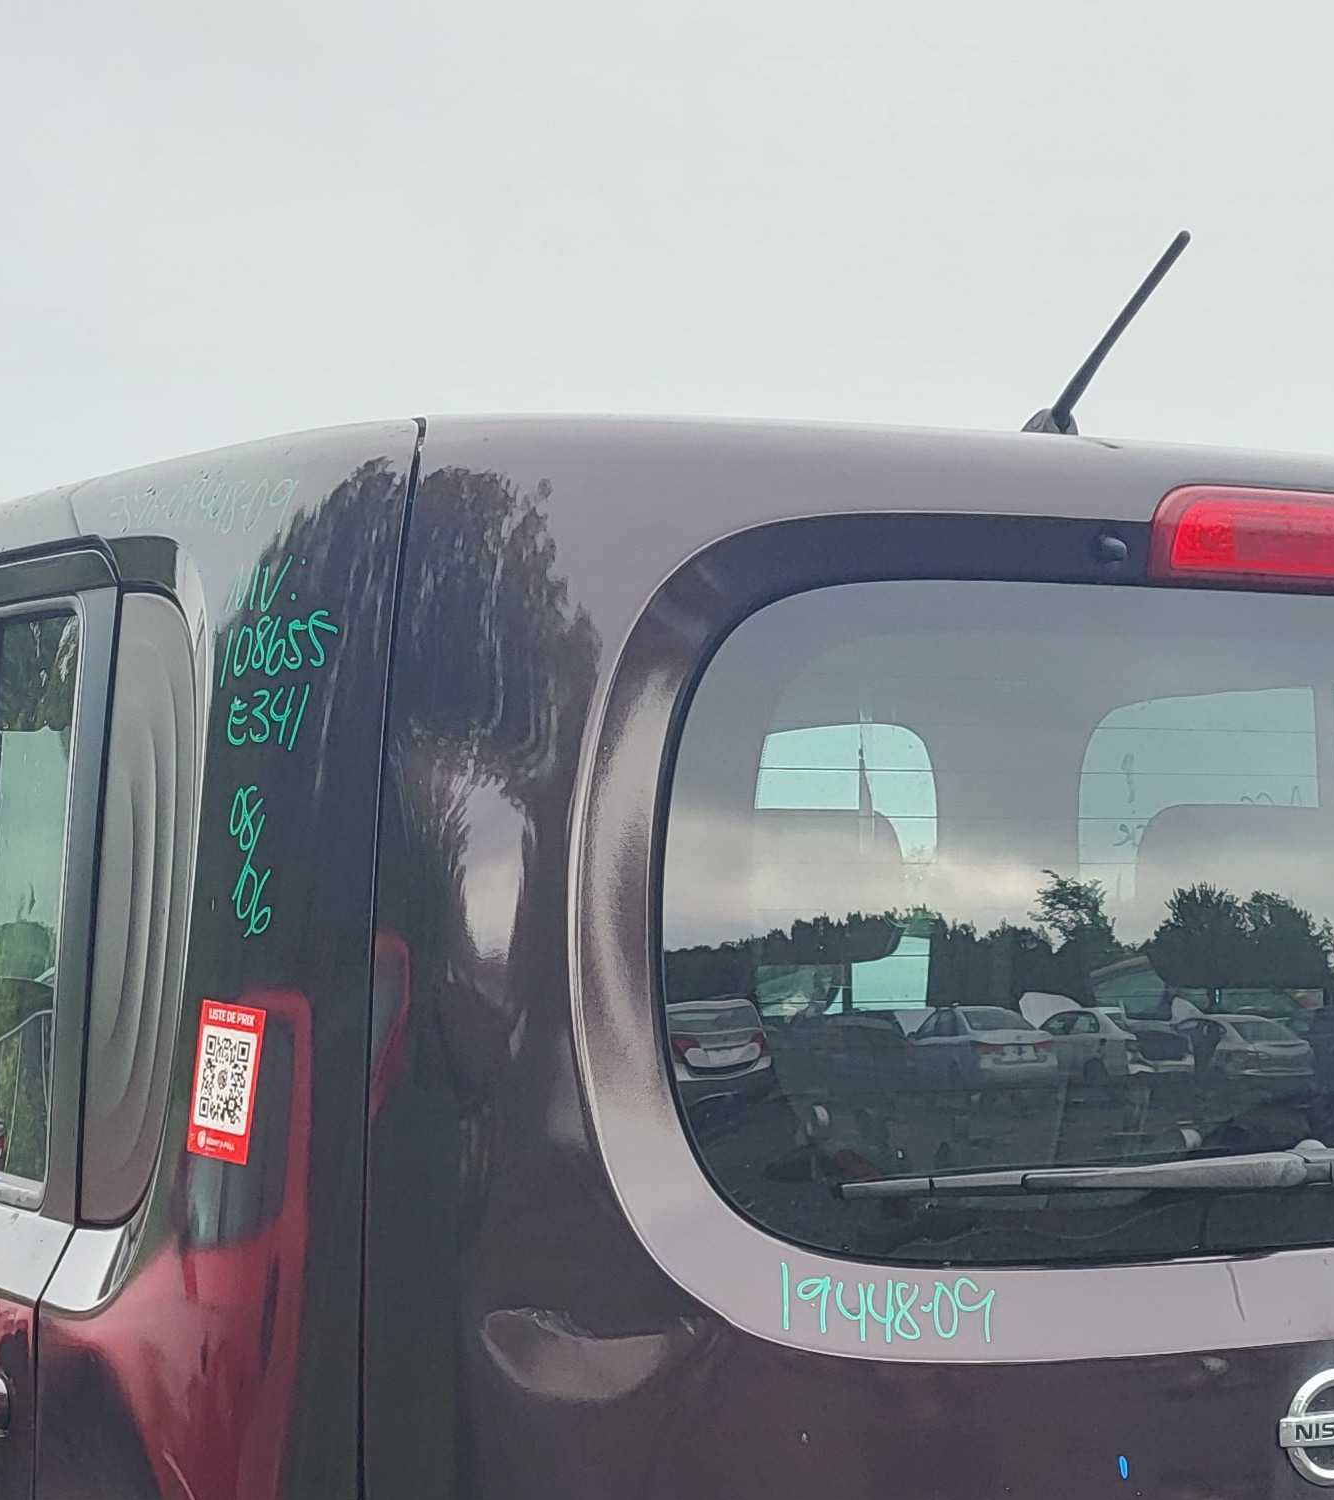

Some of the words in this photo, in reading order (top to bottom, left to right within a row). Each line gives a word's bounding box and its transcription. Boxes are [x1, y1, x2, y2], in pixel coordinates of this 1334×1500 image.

[220, 608, 338, 688] 108655
[227, 683, 311, 752] E341
[208, 1007, 228, 1022] LISTE
[227, 1010, 238, 1024] DE
[237, 1012, 256, 1028] PRIX
